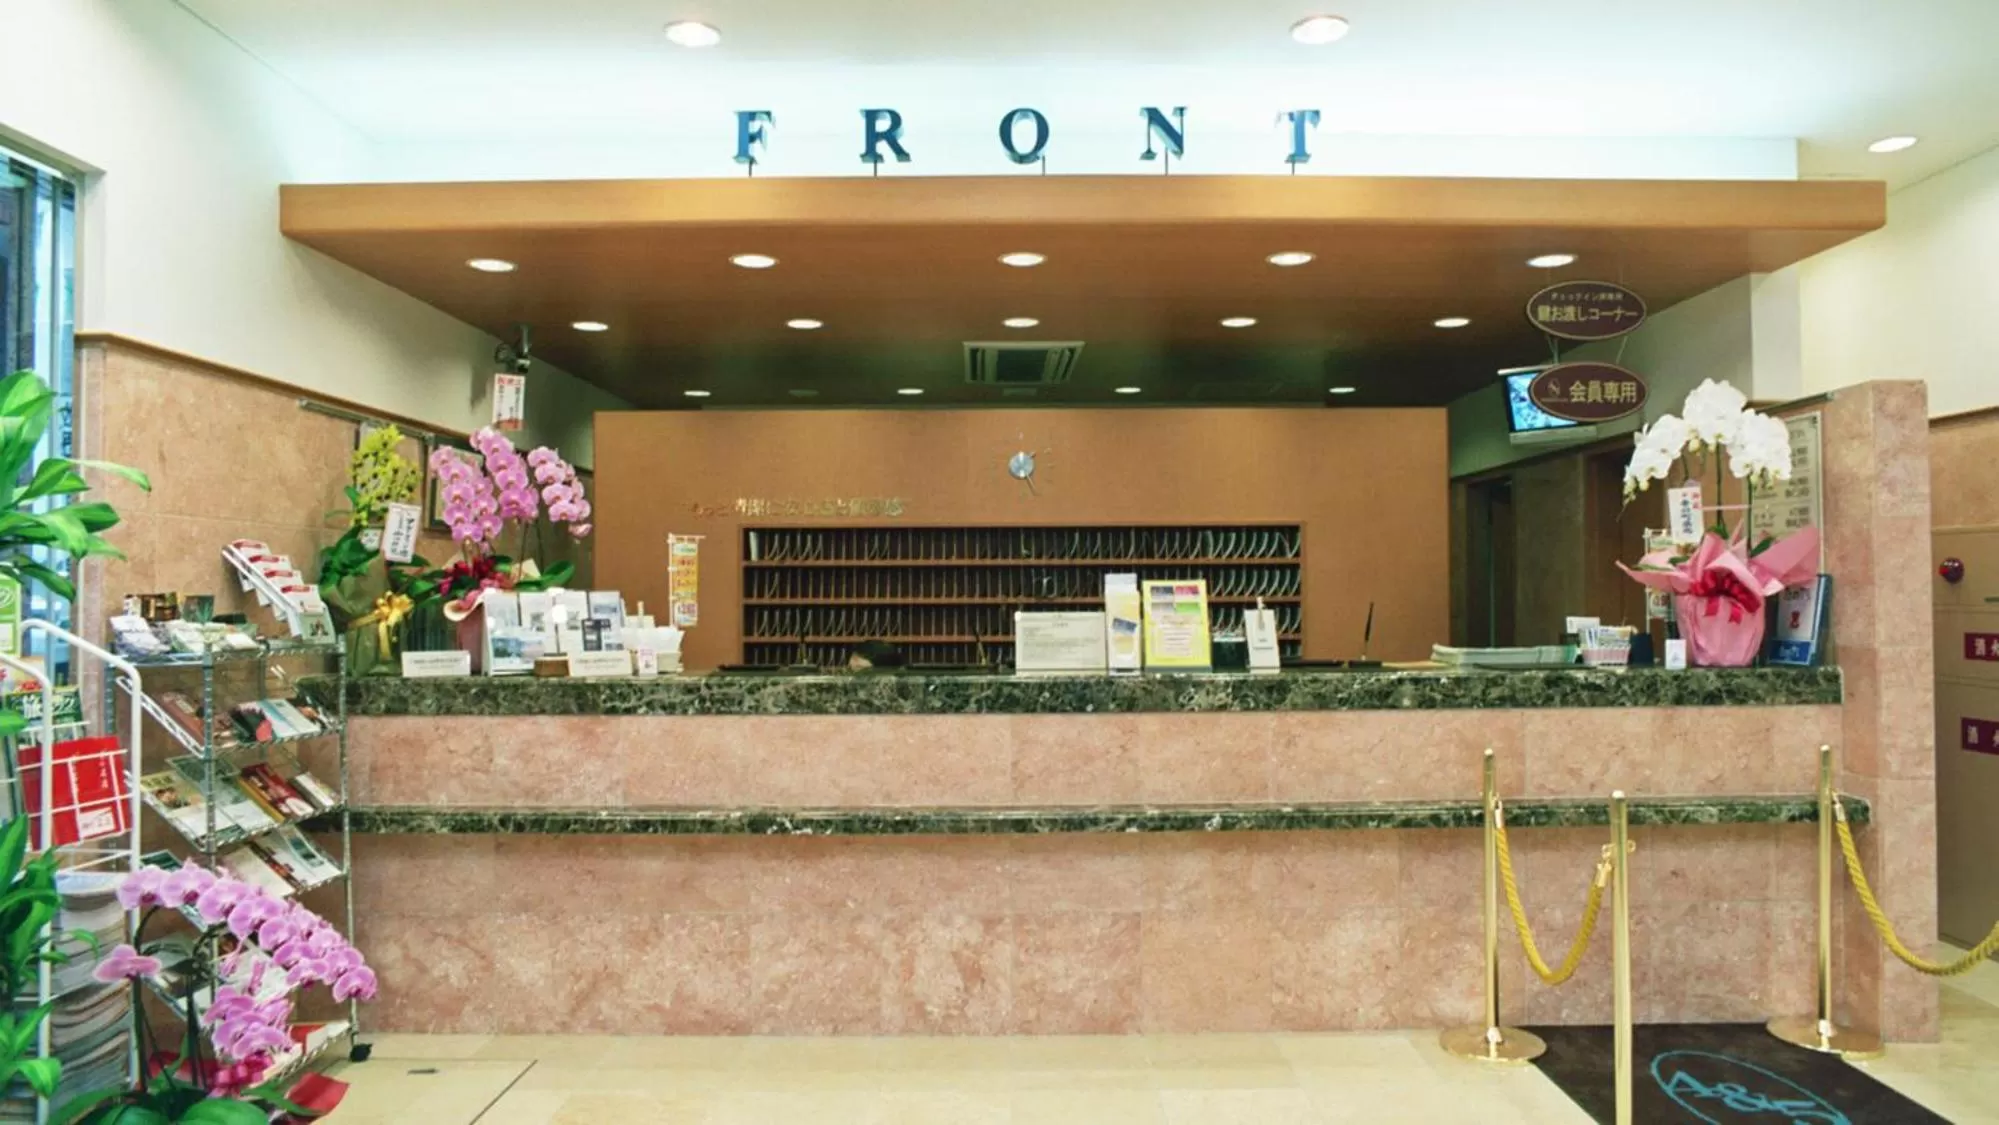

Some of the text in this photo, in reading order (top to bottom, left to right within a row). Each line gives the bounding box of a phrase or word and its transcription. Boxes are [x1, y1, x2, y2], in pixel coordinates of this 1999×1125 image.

[733, 107, 1321, 164] FRONT
[1569, 380, 1636, 403] 会員専用
